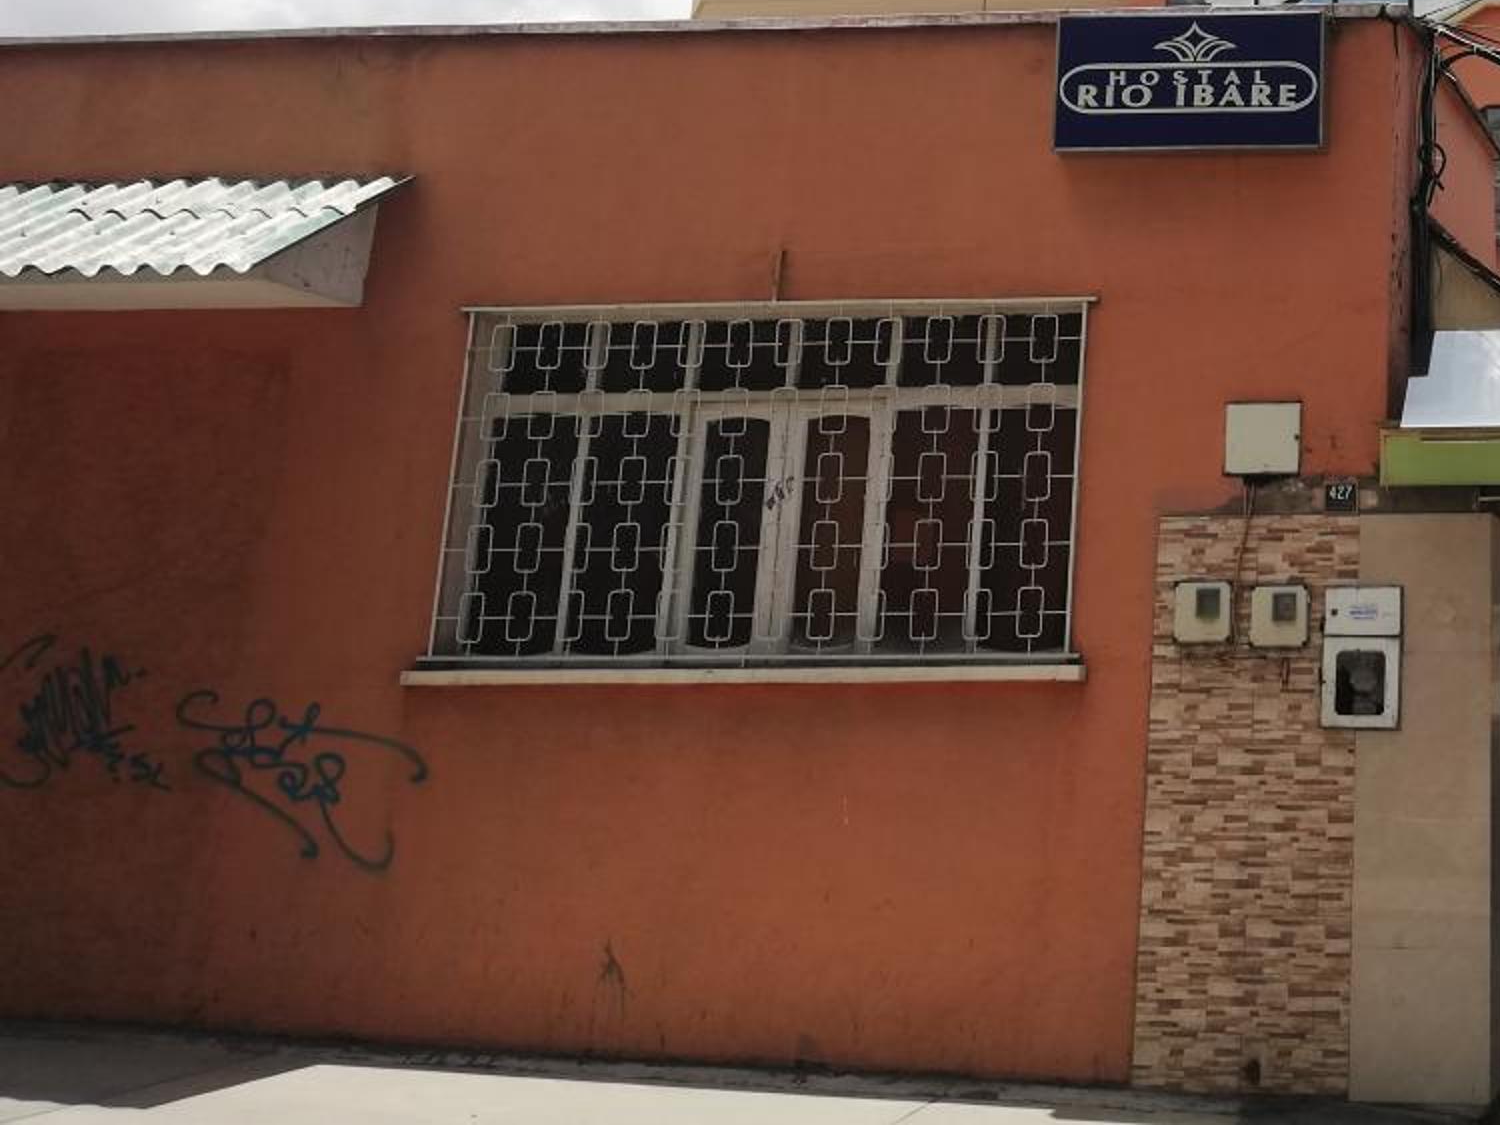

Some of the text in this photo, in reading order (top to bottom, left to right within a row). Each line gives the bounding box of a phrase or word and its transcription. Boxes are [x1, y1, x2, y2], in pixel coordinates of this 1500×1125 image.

[1109, 69, 1267, 86] HOSTAL
[1077, 83, 1298, 108] RIO IBARE
[1329, 485, 1353, 500] 427
